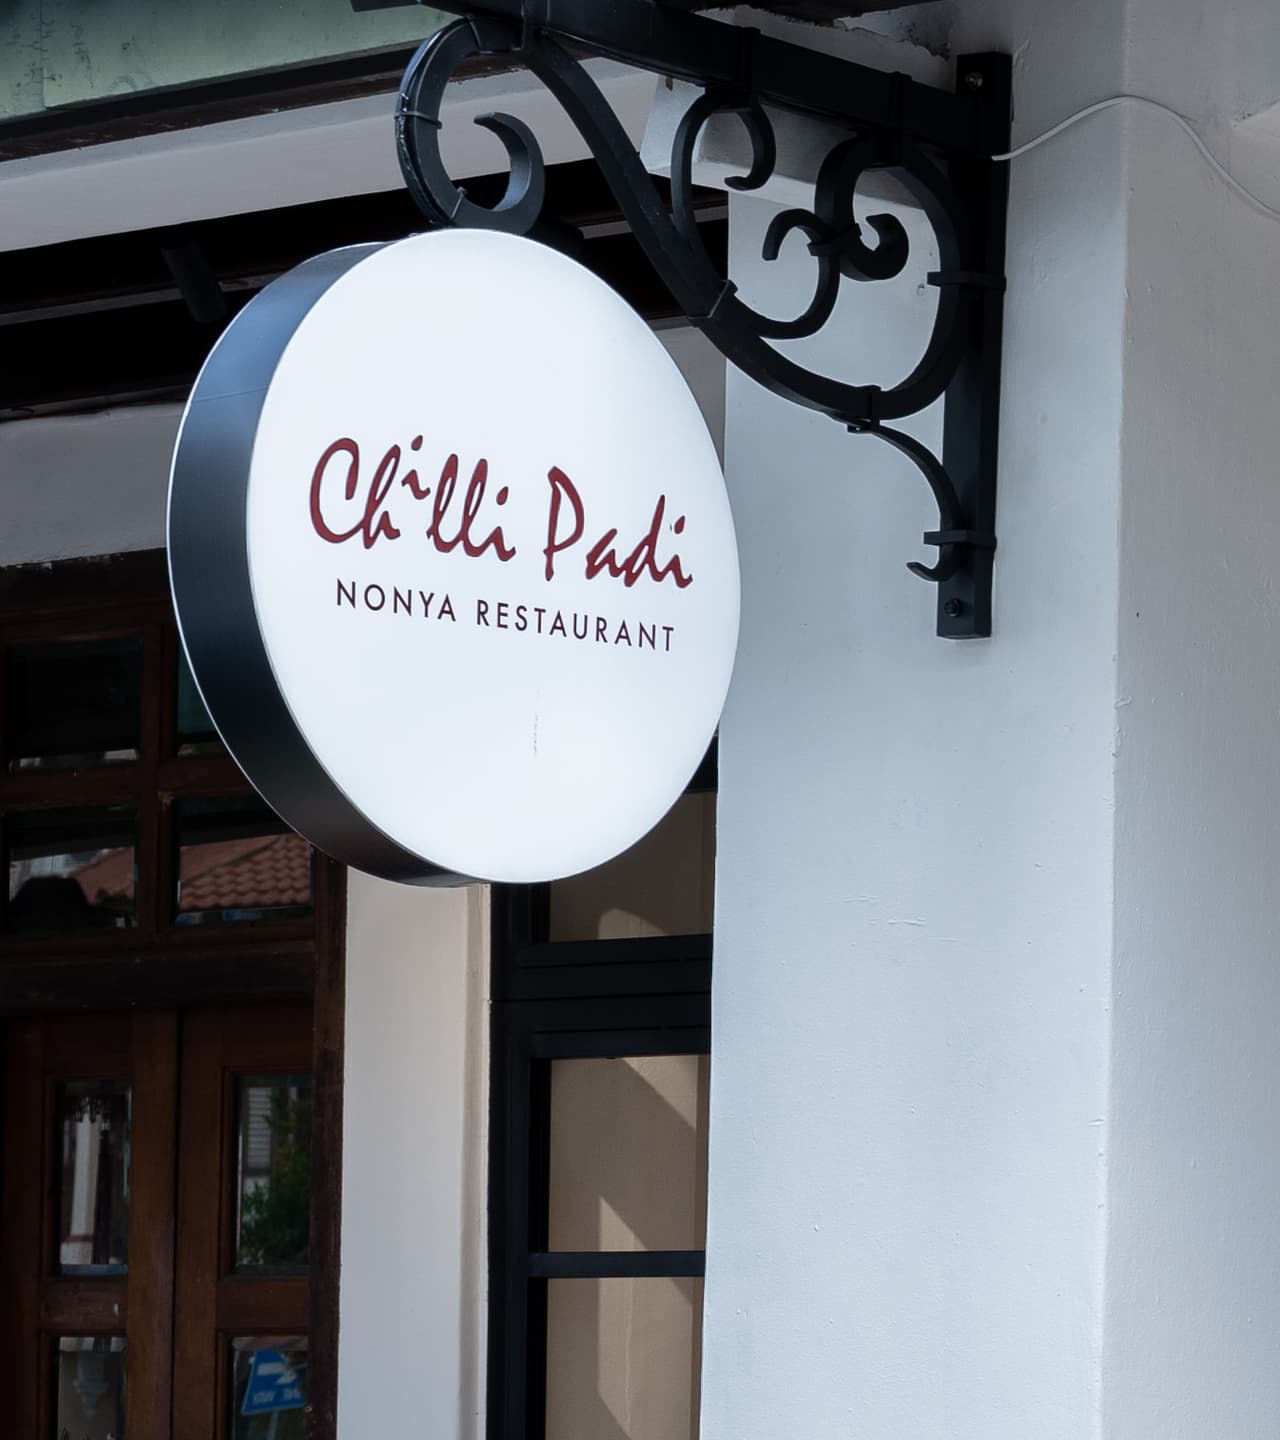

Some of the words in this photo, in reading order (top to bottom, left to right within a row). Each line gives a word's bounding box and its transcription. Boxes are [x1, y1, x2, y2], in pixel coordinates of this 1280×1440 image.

[308, 433, 518, 563] Chilli
[541, 464, 695, 590] Padi
[336, 577, 458, 623] NONYA
[475, 598, 677, 653] RESTAURANT
